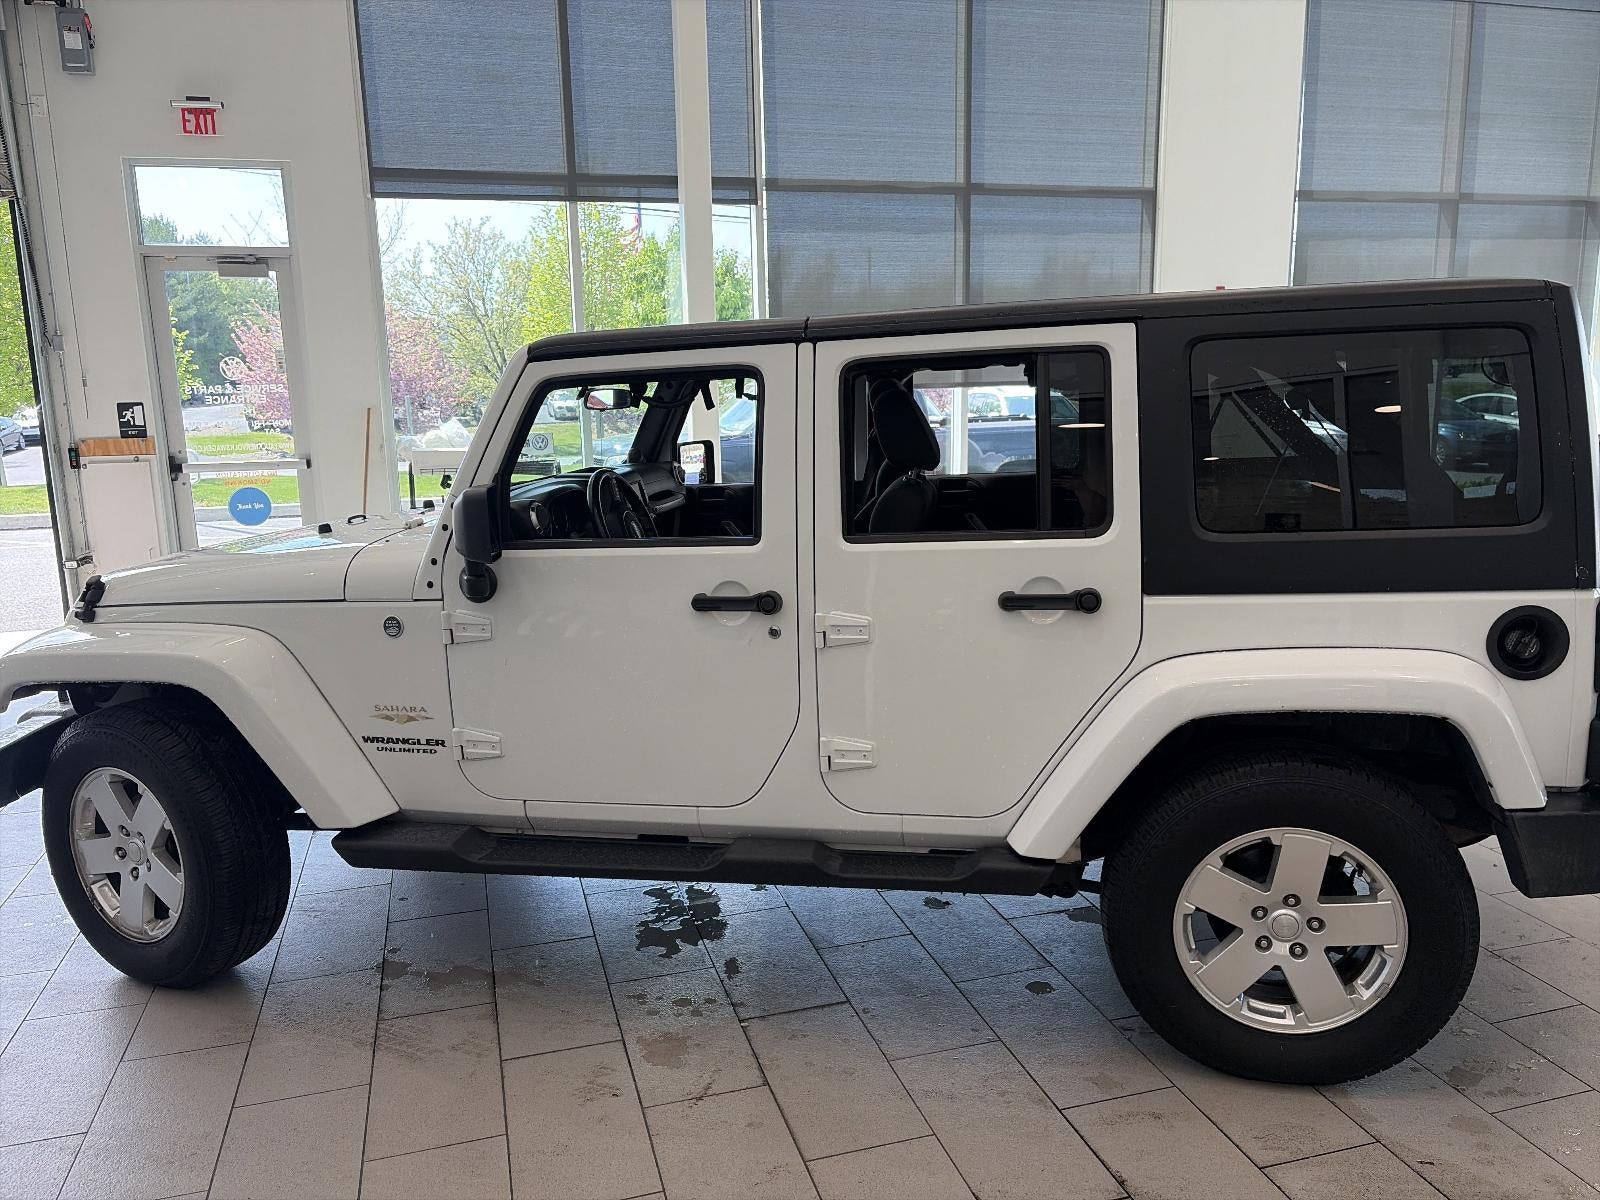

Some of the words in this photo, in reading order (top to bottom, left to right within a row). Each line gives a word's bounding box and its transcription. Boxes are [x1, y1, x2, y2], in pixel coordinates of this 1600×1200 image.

[181, 107, 217, 135] EXIT
[252, 502, 265, 511] You
[374, 704, 428, 713] SAHARA
[361, 735, 448, 748] WRANGLER
[376, 746, 438, 755] UNLIMITED
